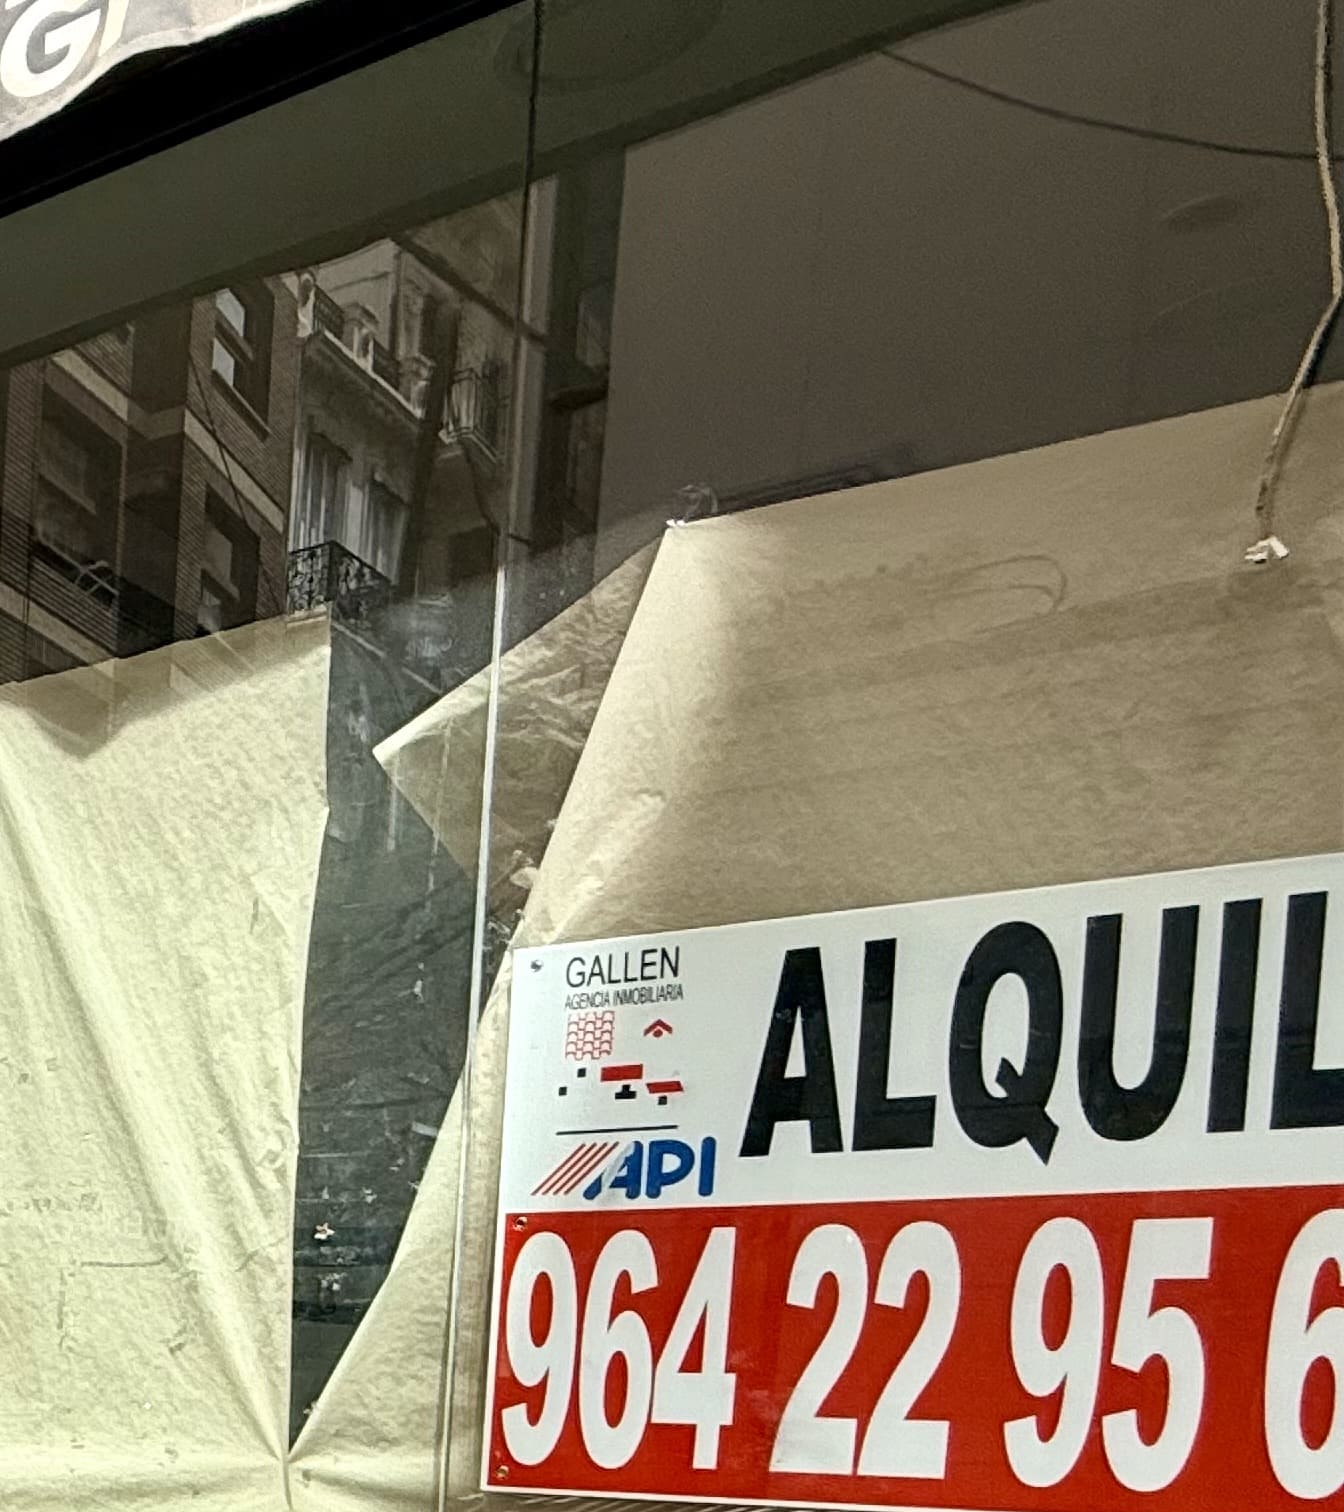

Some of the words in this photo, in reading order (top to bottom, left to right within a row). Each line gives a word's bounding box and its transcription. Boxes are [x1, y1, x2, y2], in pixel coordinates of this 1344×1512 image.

[565, 945, 681, 989] GALLEN
[564, 990, 611, 1010] AGENCIA
[612, 982, 684, 1006] INMOBILIARIA
[582, 1135, 717, 1201] API
[500, 1225, 737, 1472] 964
[768, 1220, 962, 1481] 22
[1002, 1215, 1216, 1494] 95
[1264, 1208, 1344, 1501] 6
